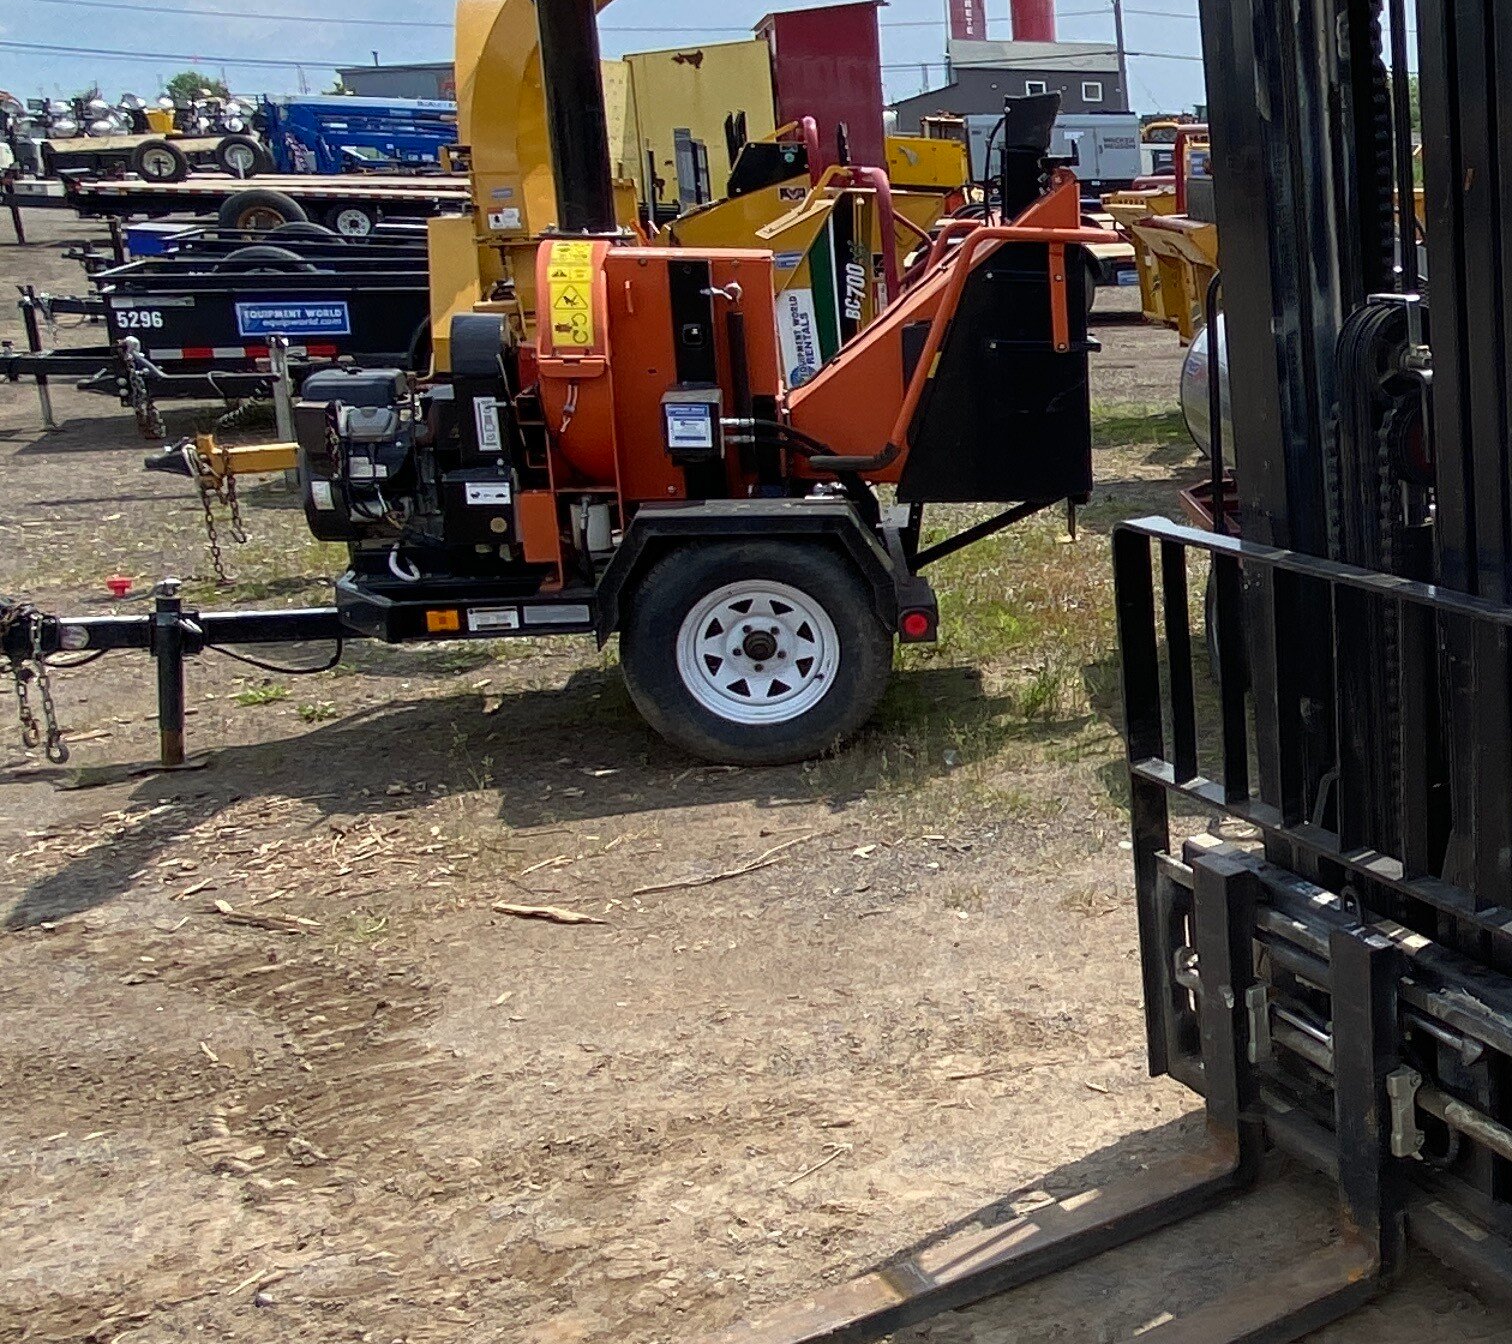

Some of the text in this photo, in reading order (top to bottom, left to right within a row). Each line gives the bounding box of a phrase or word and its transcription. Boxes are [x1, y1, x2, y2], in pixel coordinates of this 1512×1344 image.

[844, 262, 866, 320] BC700
[115, 311, 164, 328] 5296
[304, 308, 342, 318] WORLD
[789, 296, 799, 327] WORLD
[800, 311, 815, 365] RENTALS
